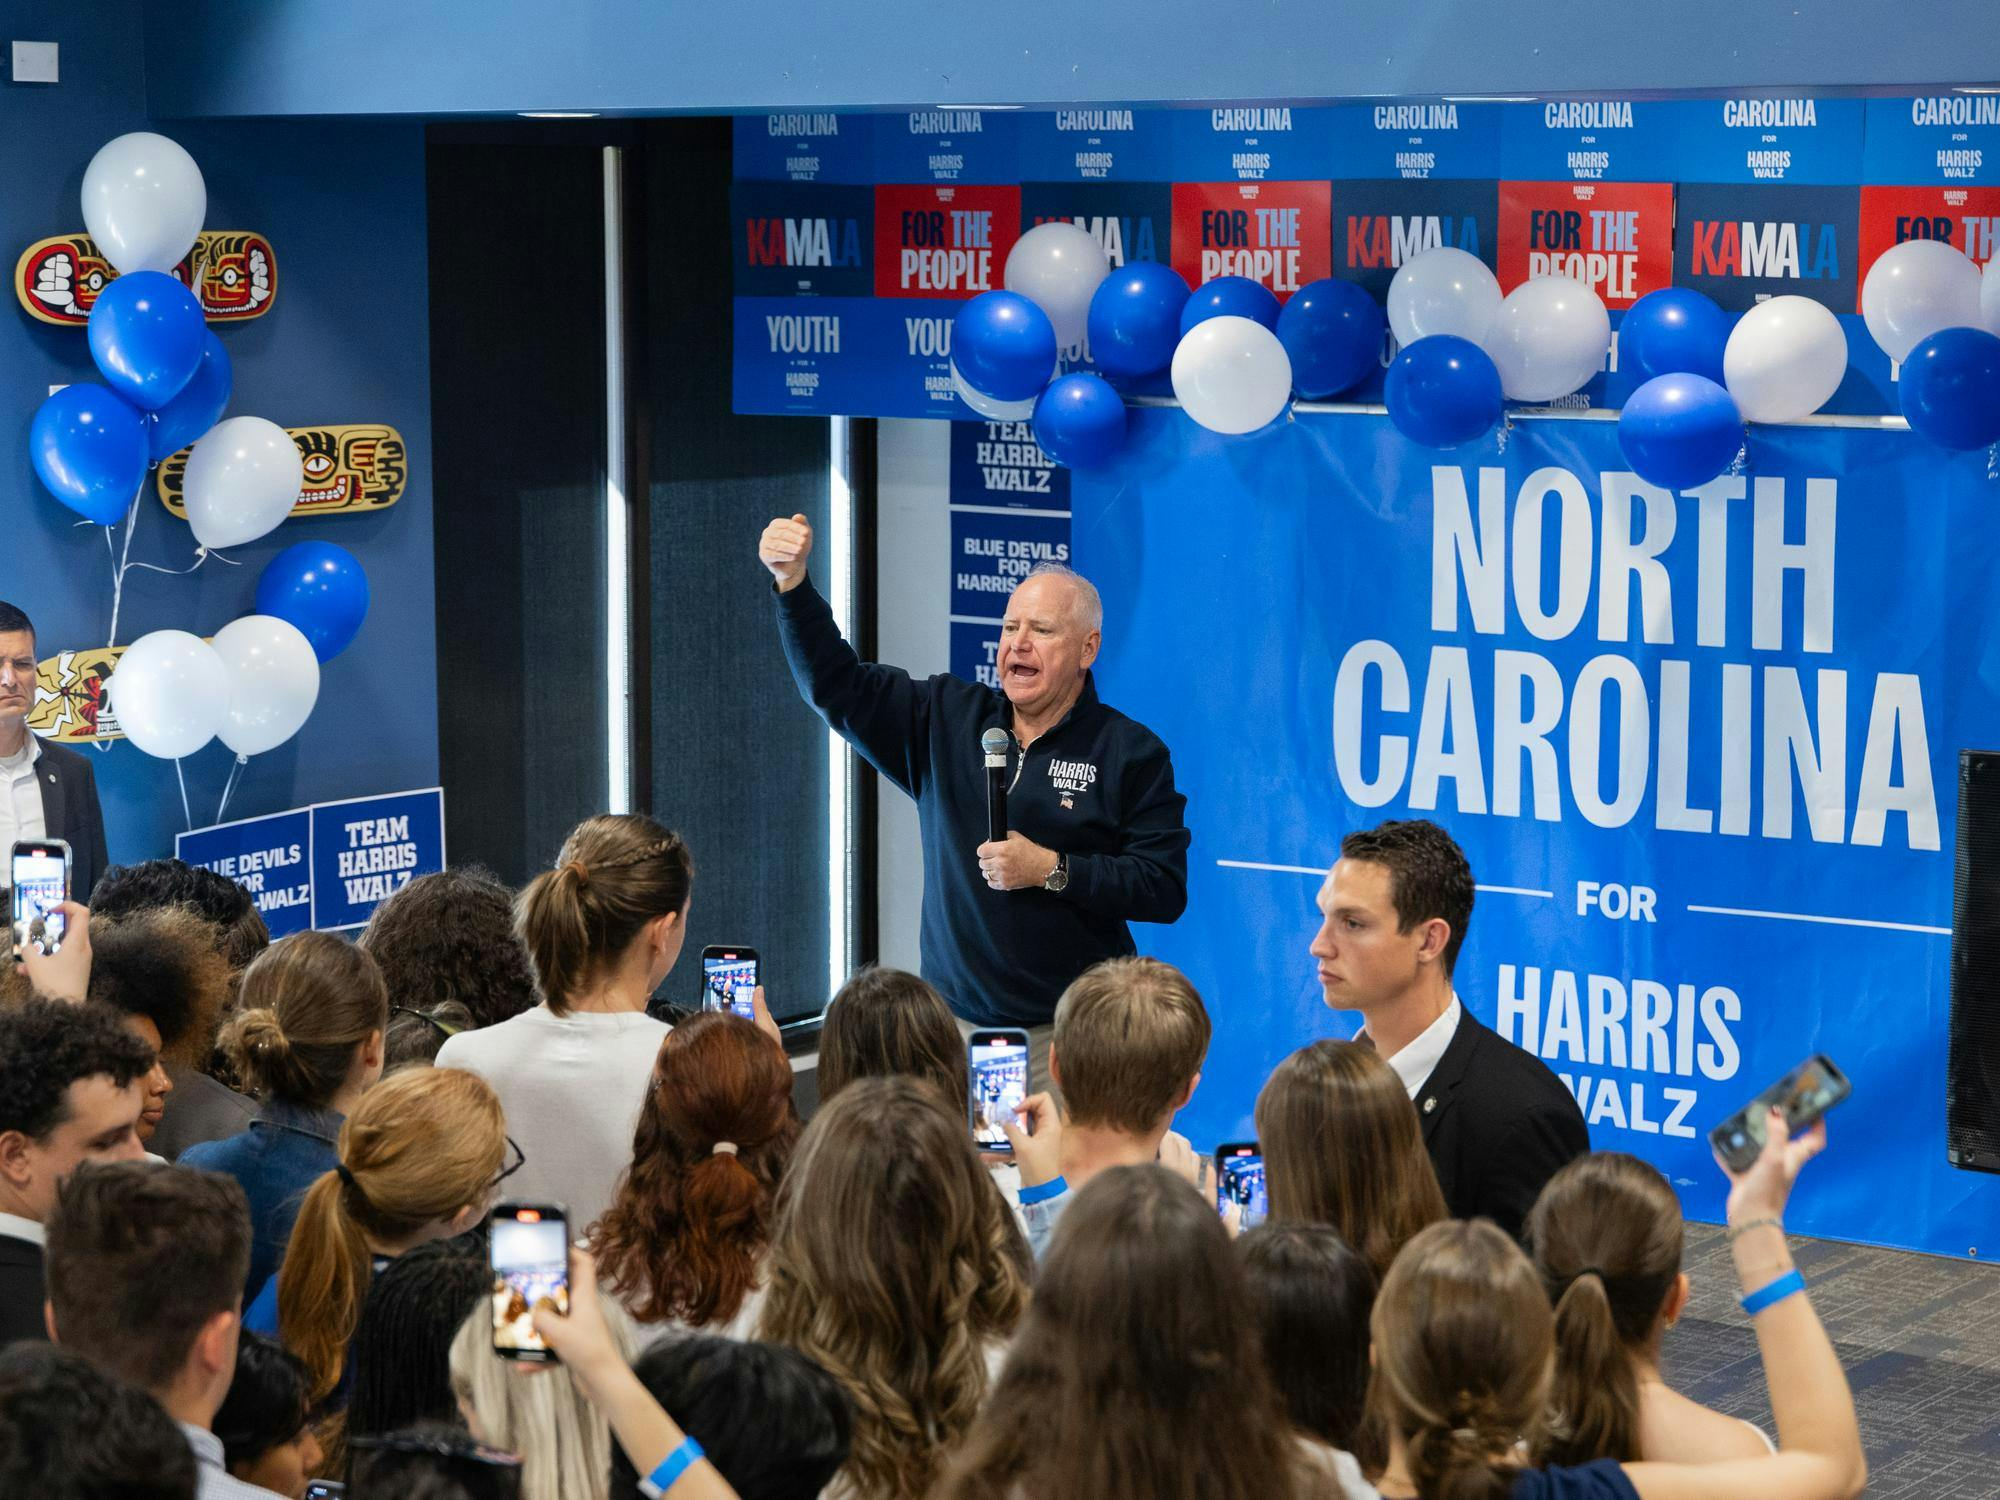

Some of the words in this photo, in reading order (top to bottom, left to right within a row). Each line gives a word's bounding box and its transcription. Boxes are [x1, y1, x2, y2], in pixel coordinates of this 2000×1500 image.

[768, 114, 838, 136] CAROLINA
[909, 111, 982, 134] CAROLINA
[1055, 110, 1134, 131] CAROLINA
[1212, 108, 1292, 131] CAROLINA
[1374, 105, 1458, 130] CAROLINA
[1544, 102, 1633, 128] CAROLINA
[1723, 99, 1817, 127] CAROLINA
[929, 155, 963, 170] HARRIS
[1076, 152, 1112, 168] HARRIS
[1232, 153, 1270, 169] HARRIS
[1396, 152, 1435, 168] HARRIS
[1567, 152, 1609, 168] HARRIS
[1747, 151, 1791, 168] HARRIS
[1937, 150, 1982, 167] HARRIS
[934, 170, 958, 179] WALZ
[1081, 168, 1107, 177] WALZ
[1238, 169, 1264, 178] WALZ
[1401, 169, 1429, 178] WALZ
[1574, 169, 1602, 178] WALZ
[1754, 168, 1784, 178] WALZ
[1943, 168, 1975, 178] WALZ
[1944, 191, 1967, 200] HARRIS
[902, 211, 945, 247] FOR
[950, 211, 992, 248] THE
[1202, 210, 1248, 247] FOR
[1255, 208, 1300, 247] THE
[1530, 210, 1582, 250] FOR
[1589, 211, 1639, 251] THE
[747, 218, 862, 267] KAMALA
[1691, 221, 1839, 280] KAMALA
[901, 250, 991, 290] PEOPLE
[1201, 249, 1300, 291] PEOPLE
[766, 316, 840, 353] YOUTH
[905, 318, 954, 356] YOU
[982, 467, 1051, 493] WALZ
[964, 537, 1005, 556] BLUE
[1008, 541, 1069, 560] DEVILS
[1431, 465, 1838, 653] NORTH
[998, 559, 1031, 576] FOR
[1333, 640, 1941, 852] CAROLINA
[1047, 758, 1098, 783] HARRIS
[1053, 777, 1088, 791] WALZ
[345, 815, 409, 848] TEAM
[239, 844, 301, 874] DEVILS
[338, 842, 417, 878] HARRIS
[344, 870, 412, 905] WALZ
[1577, 881, 1657, 923] FOR
[1497, 964, 1742, 1081] HARRIS
